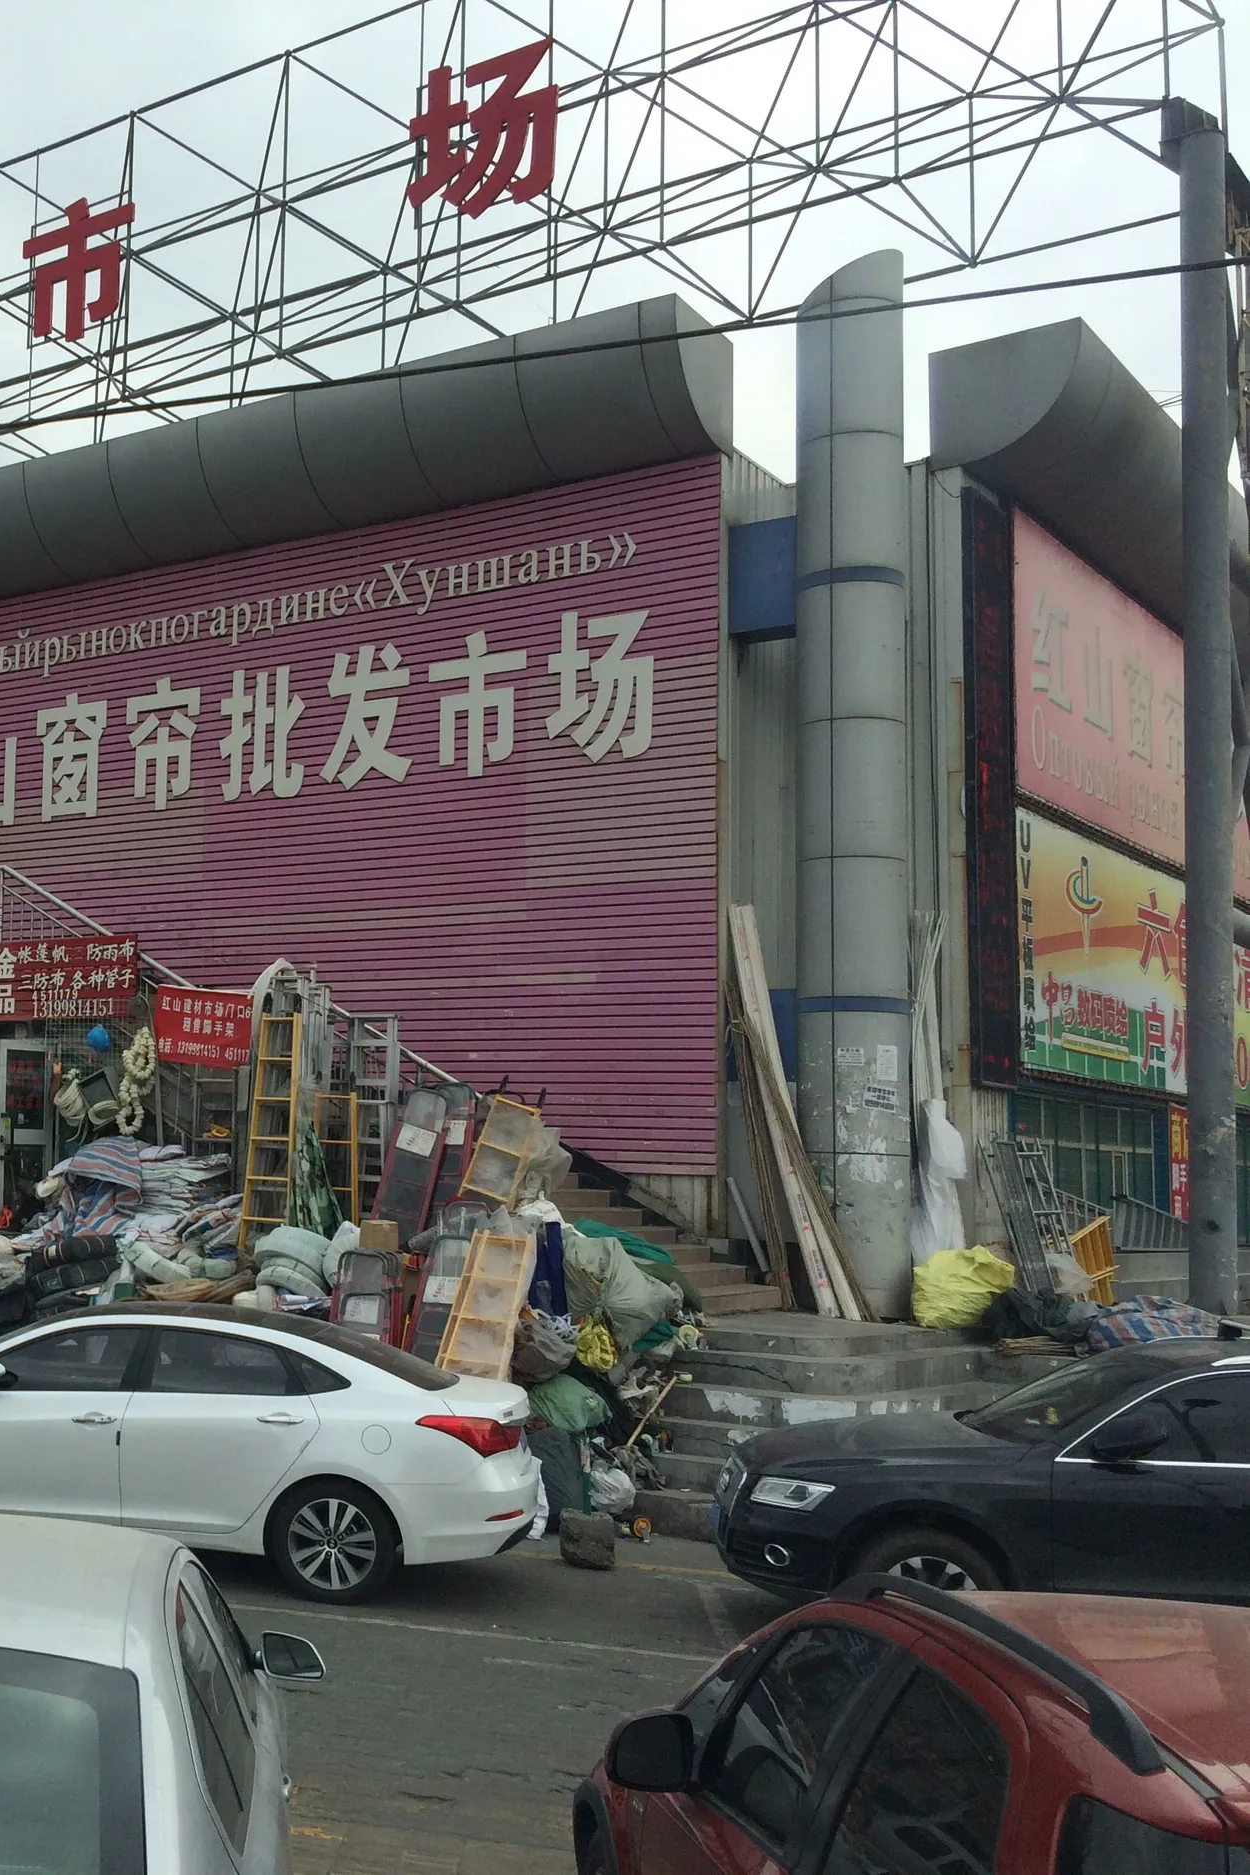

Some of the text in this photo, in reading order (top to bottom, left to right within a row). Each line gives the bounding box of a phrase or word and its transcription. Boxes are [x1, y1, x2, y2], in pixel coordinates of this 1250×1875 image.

[31, 988, 79, 1001] 4511179
[32, 997, 114, 1019] 13199814151
[182, 1016, 235, 1038] 租售脚手架
